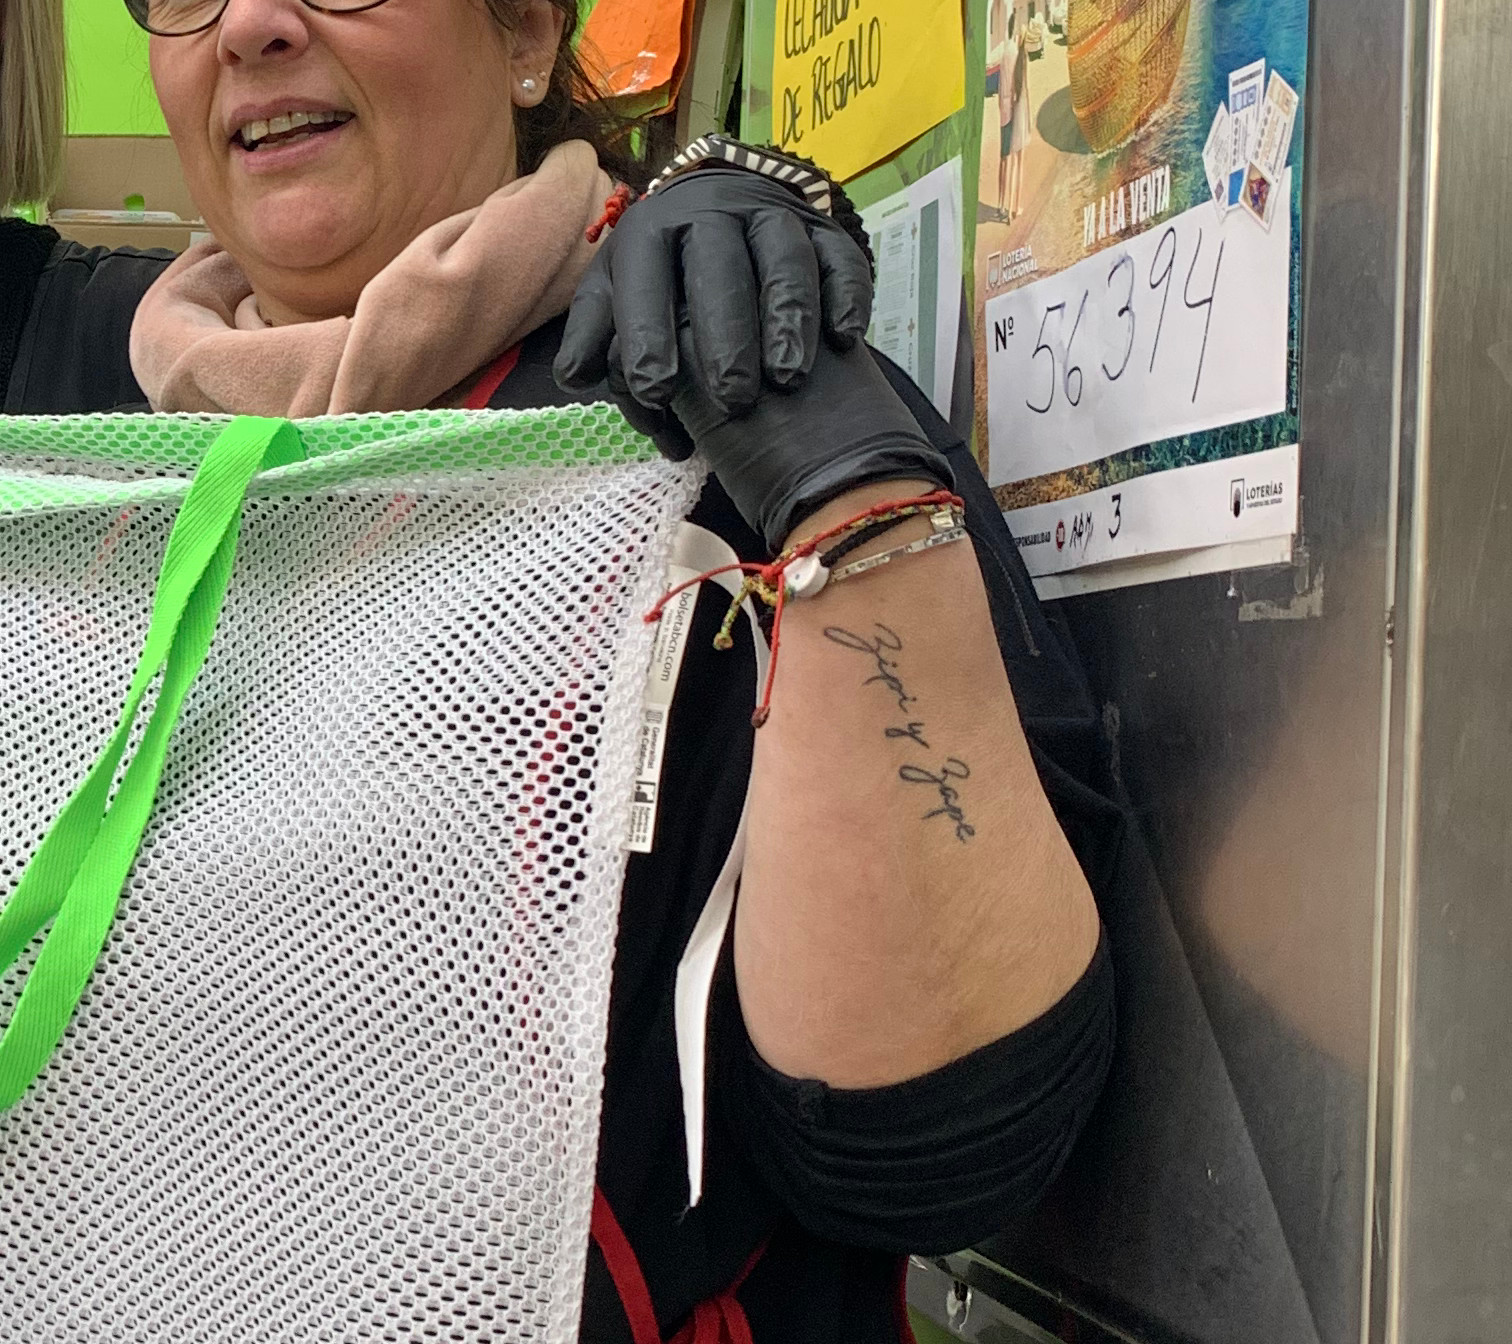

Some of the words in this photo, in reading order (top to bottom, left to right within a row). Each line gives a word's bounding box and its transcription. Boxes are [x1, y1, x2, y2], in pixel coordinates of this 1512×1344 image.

[781, 84, 805, 151] DE
[809, 15, 883, 142] REGALO
[1083, 202, 1099, 253] YA
[1109, 189, 1125, 238] LA
[1126, 164, 1171, 230] VENTA
[1001, 242, 1033, 269] LOTERÍA
[1001, 258, 1040, 284] NACIONAL
[1026, 224, 1226, 416] 56394
[1245, 480, 1284, 501] LOTERÍAS
[1013, 530, 1052, 548] SPONSABILIDAD
[660, 591, 693, 682] bolsetabcn.com
[899, 757, 975, 846] Zape
